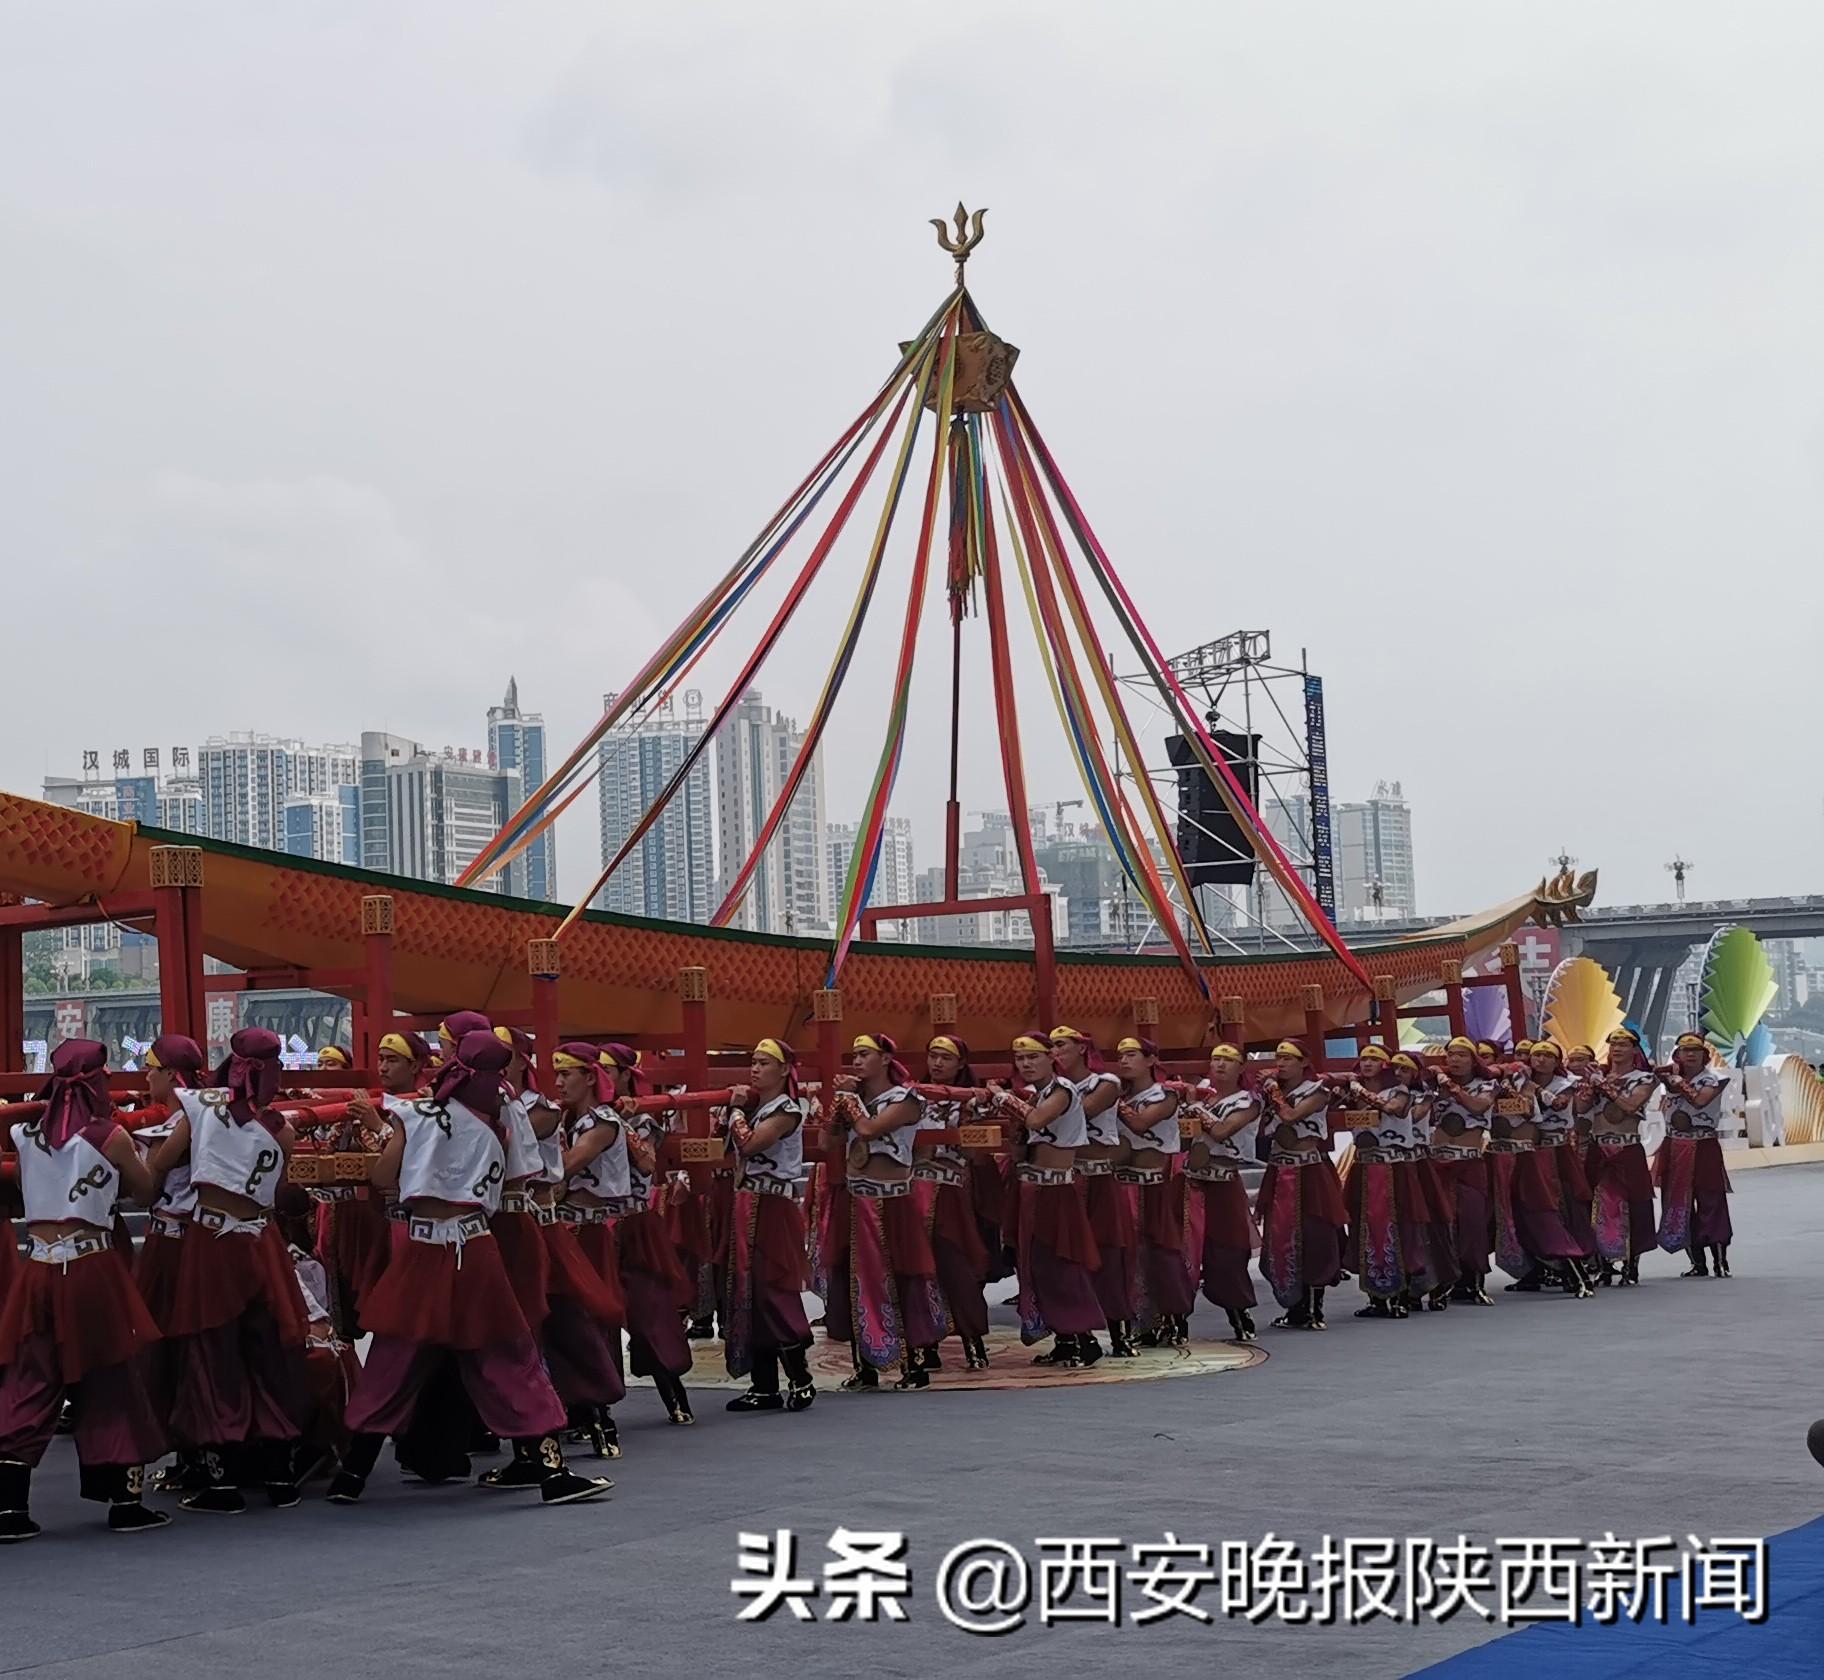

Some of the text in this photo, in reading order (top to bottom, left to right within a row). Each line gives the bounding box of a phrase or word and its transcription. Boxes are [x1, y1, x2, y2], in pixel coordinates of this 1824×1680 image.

[82, 747, 190, 770] 汉城国际
[57, 998, 235, 1043] 安 康
